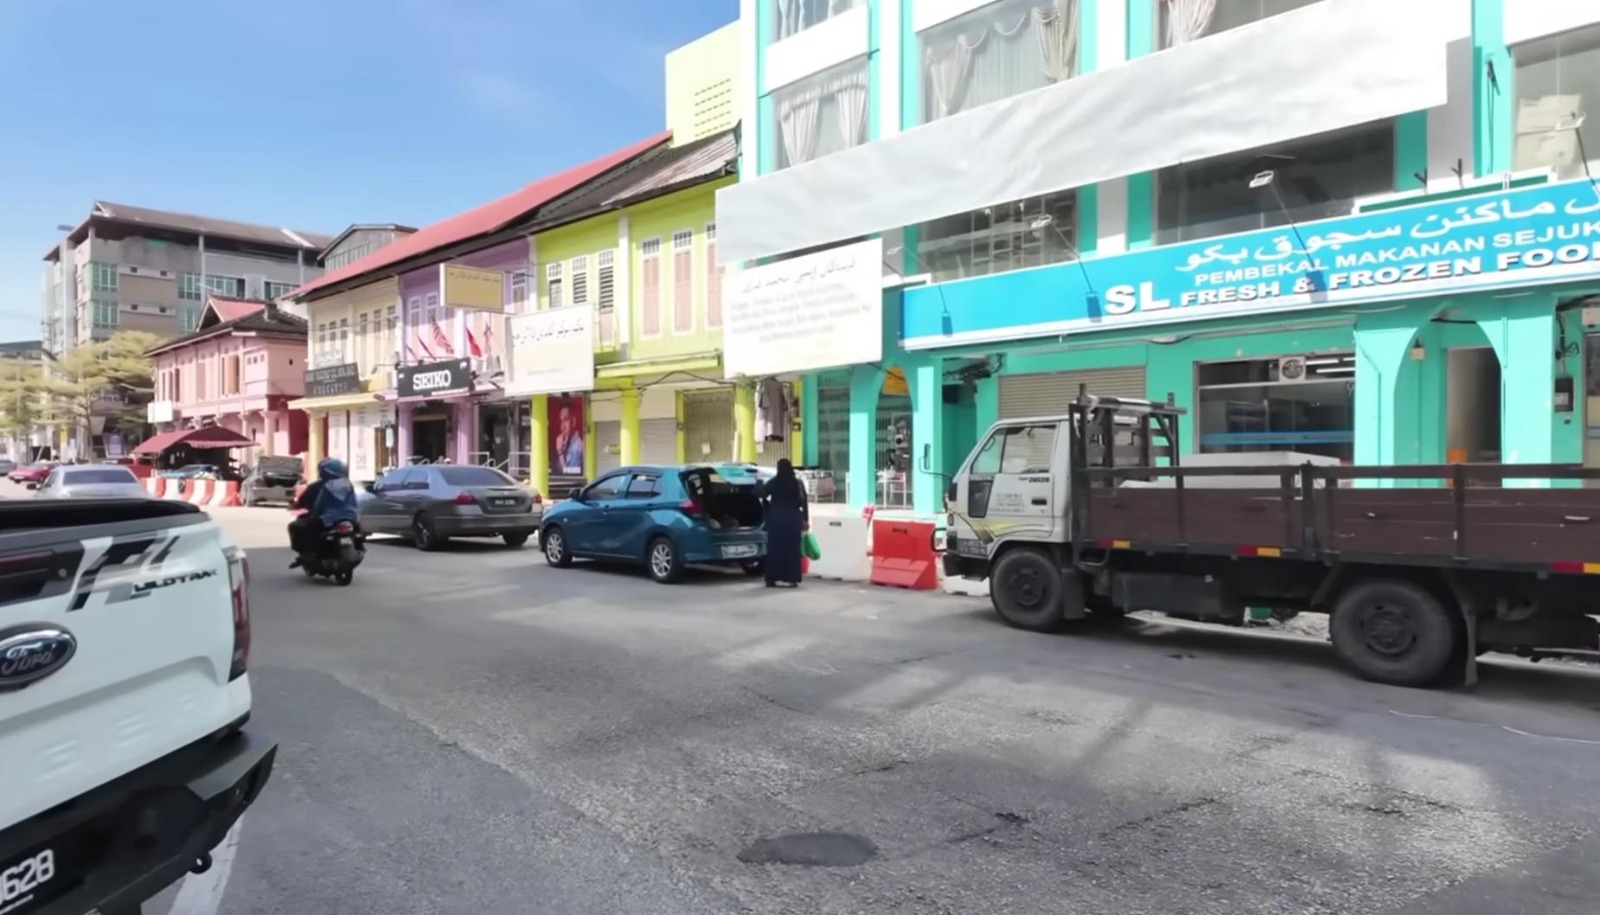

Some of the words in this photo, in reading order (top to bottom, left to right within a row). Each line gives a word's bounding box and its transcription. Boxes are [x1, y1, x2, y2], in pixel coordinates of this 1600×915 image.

[1104, 281, 1171, 315] SL
[1181, 281, 1281, 307] FRESH
[1293, 277, 1316, 294] &
[1329, 256, 1482, 290] FROZEN
[1497, 241, 1600, 271] FOO
[1195, 257, 1328, 286] PEMBEKAL
[1335, 236, 1485, 268] MAKANAN
[1492, 221, 1600, 248] SEJUK
[413, 370, 452, 391] SEIKO
[1, 641, 57, 675] Ford
[0, 849, 54, 904] 628
